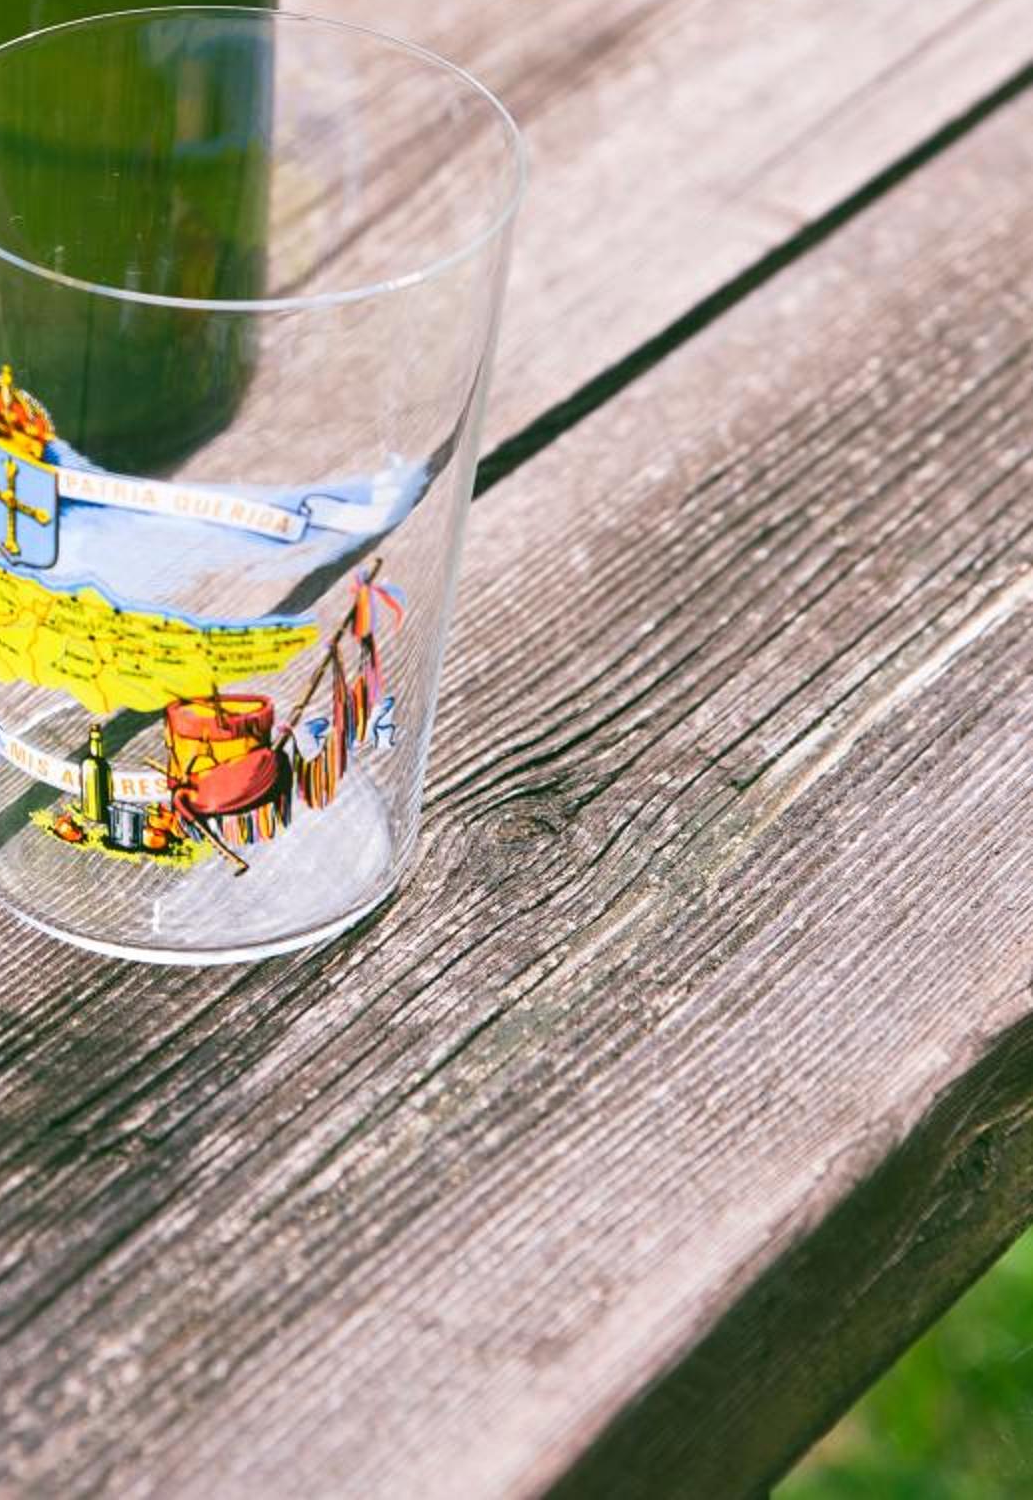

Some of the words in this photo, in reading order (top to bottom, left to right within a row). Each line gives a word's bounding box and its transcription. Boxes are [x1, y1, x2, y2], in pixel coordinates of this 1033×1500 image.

[67, 473, 157, 504] PATRIA
[174, 491, 290, 533] QUERIDA
[9, 741, 50, 776] MIS
